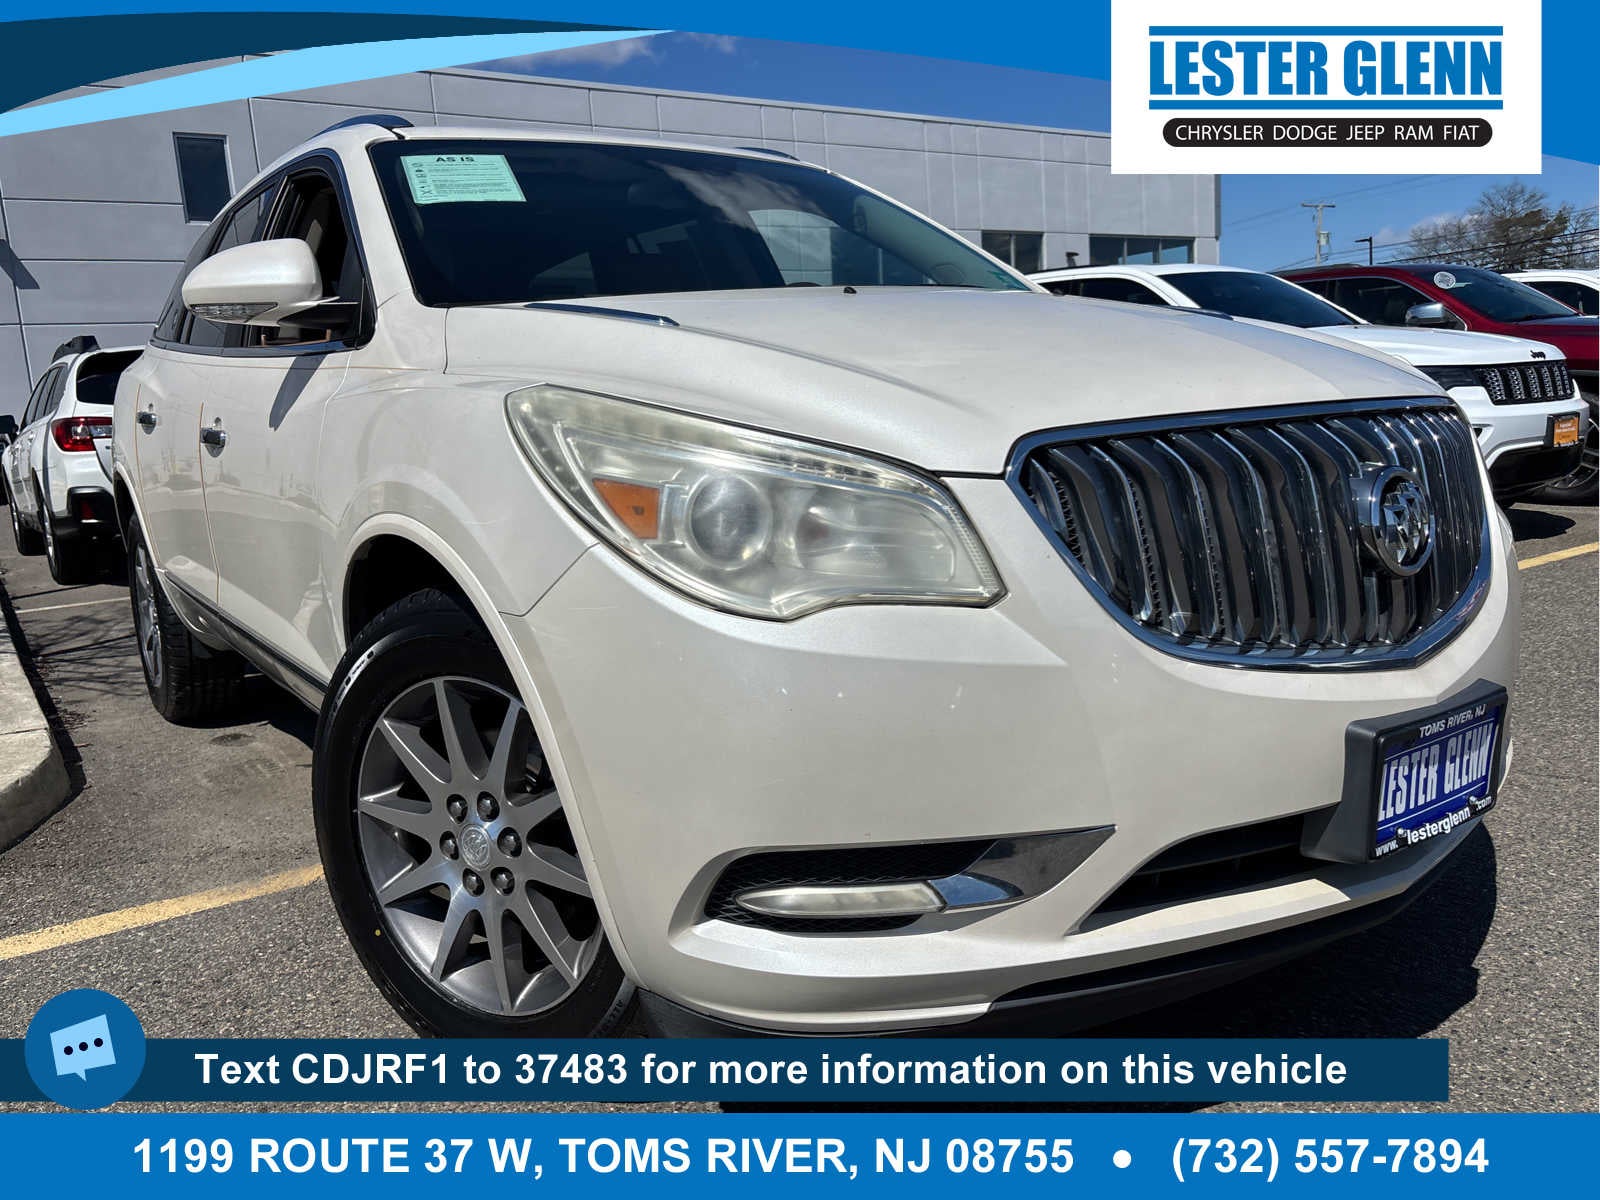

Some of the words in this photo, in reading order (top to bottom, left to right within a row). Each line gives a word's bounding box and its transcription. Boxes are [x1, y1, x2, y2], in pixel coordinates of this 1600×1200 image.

[1419, 719, 1446, 738] TOMS
[1446, 709, 1474, 729] RIVER,
[1474, 703, 1487, 718] NJ
[1377, 744, 1440, 822] LESTER
[1443, 722, 1494, 795] GLENN
